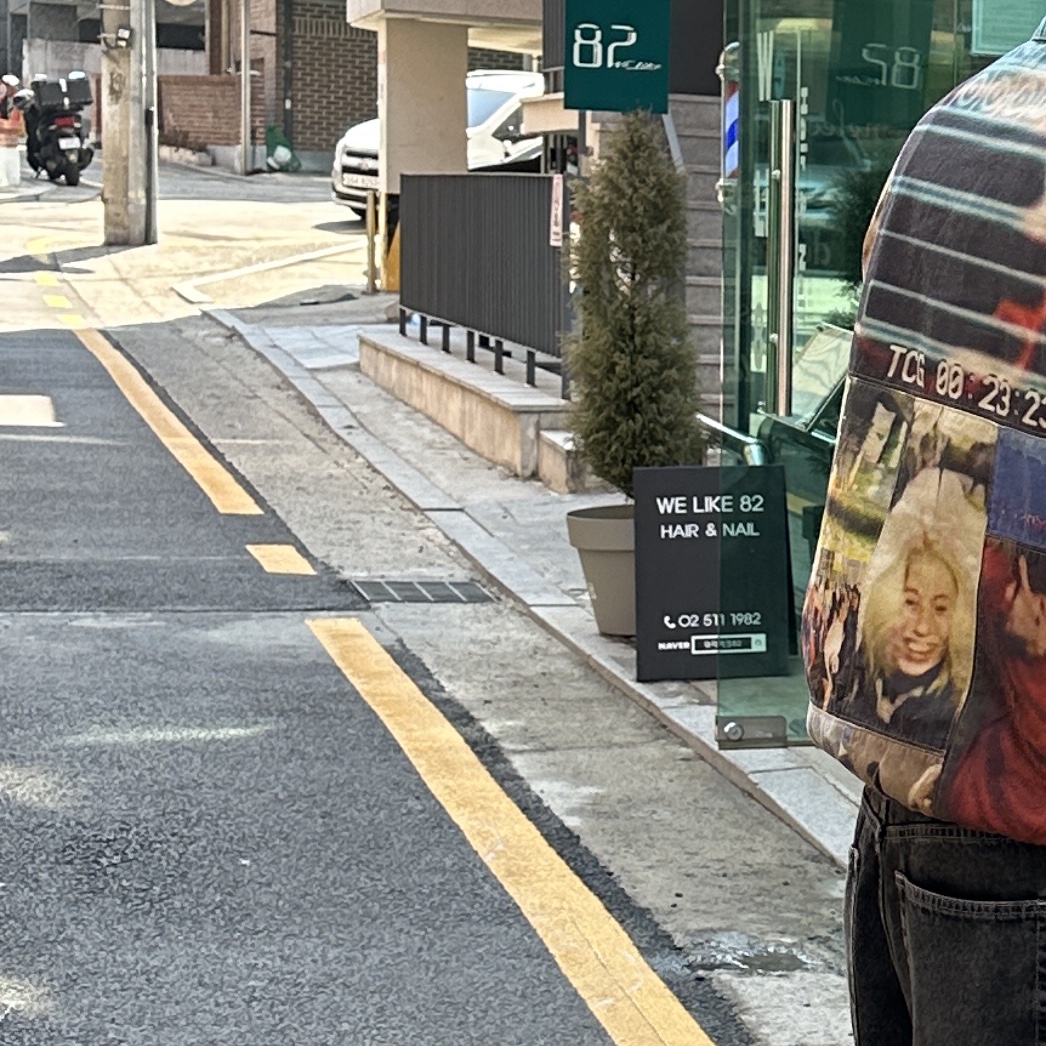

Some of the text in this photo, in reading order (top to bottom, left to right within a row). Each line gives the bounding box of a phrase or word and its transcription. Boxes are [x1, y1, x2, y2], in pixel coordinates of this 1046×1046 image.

[572, 23, 638, 69] 82
[656, 494, 765, 514] WE LIKE 82
[660, 522, 760, 539] HAIR & NAIL
[677, 612, 761, 628] 02 511 1982
